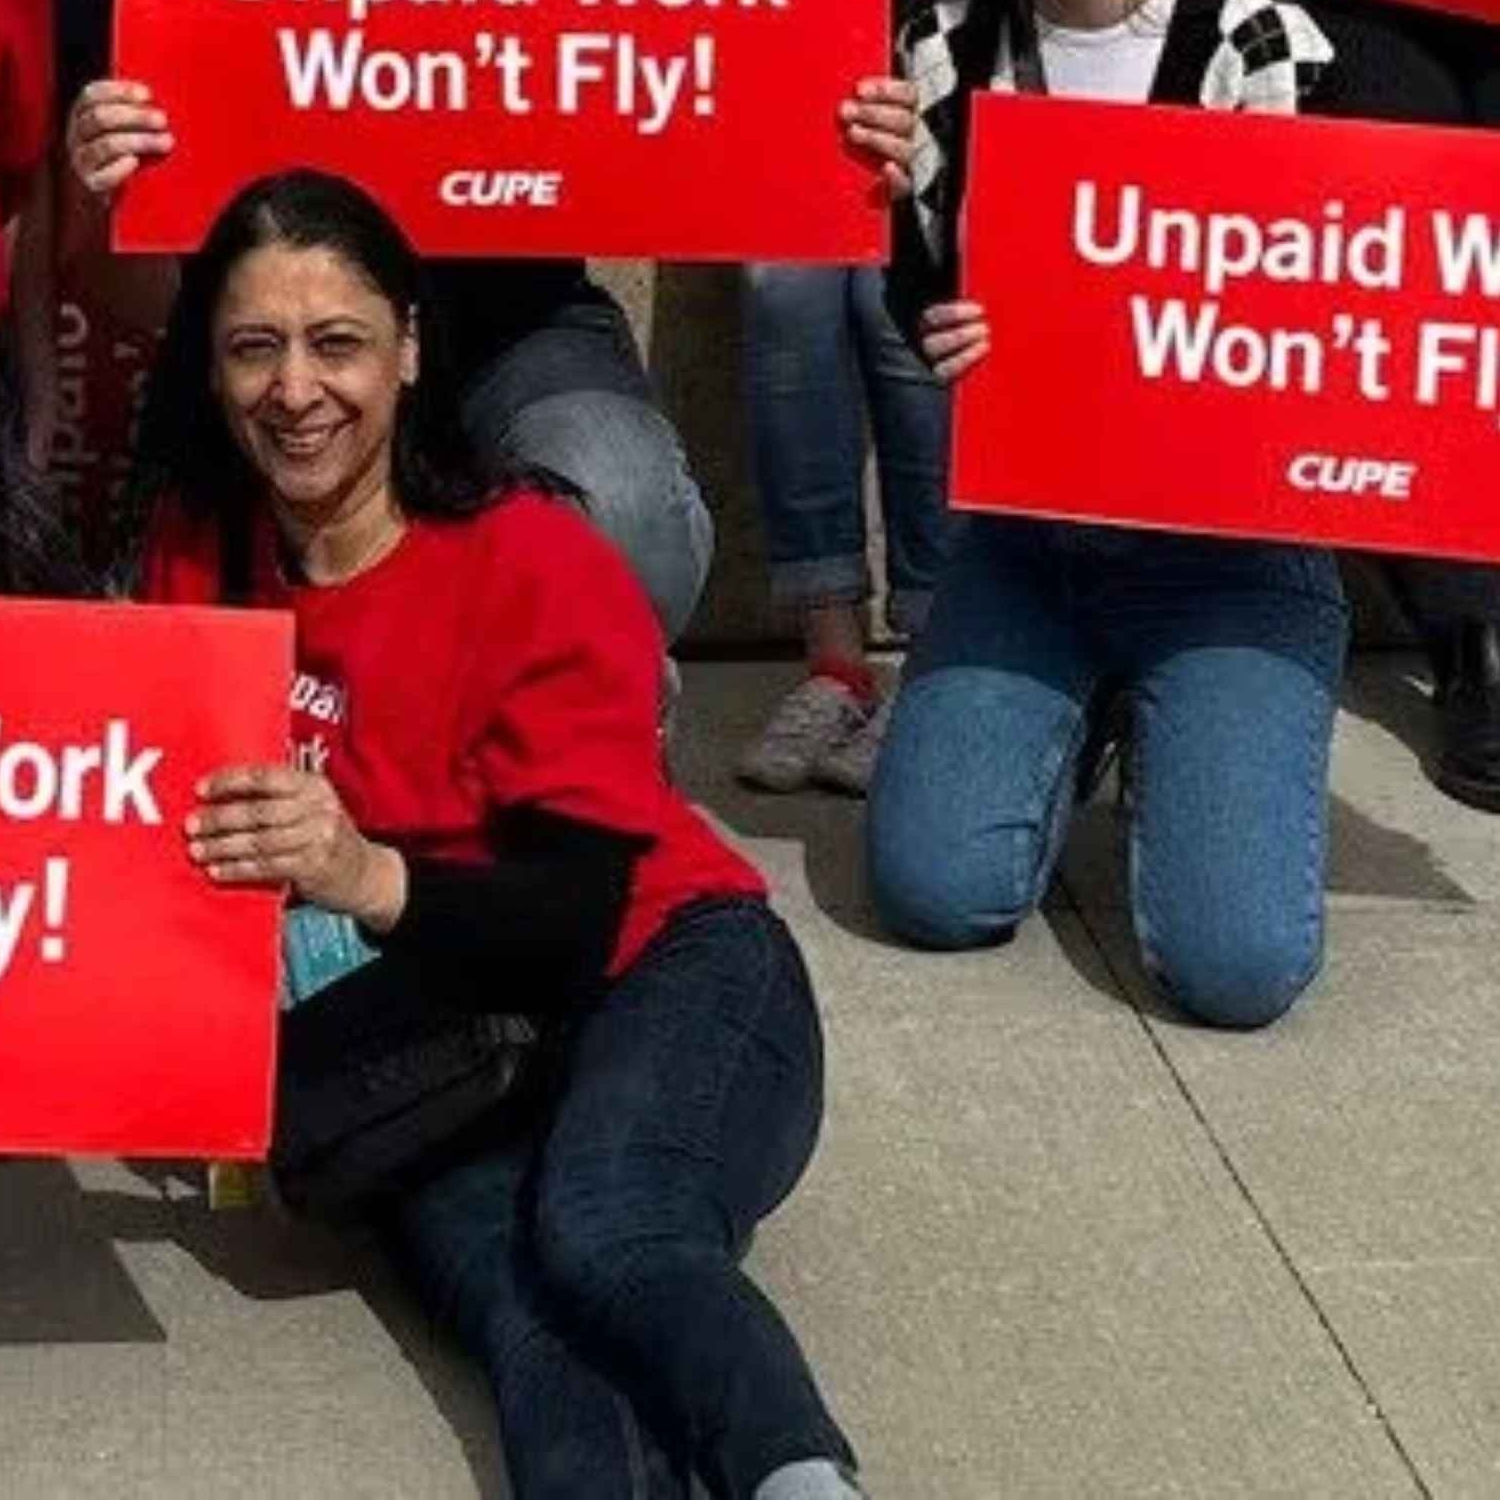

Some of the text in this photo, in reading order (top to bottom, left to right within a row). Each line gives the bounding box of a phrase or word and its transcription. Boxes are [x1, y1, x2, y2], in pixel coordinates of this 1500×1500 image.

[279, 27, 715, 133] Won't Fly!
[439, 171, 563, 207] CUPE
[1073, 181, 1404, 295] Unpaid
[1131, 295, 1500, 428] Won't Fl
[1287, 452, 1417, 501] CUPE
